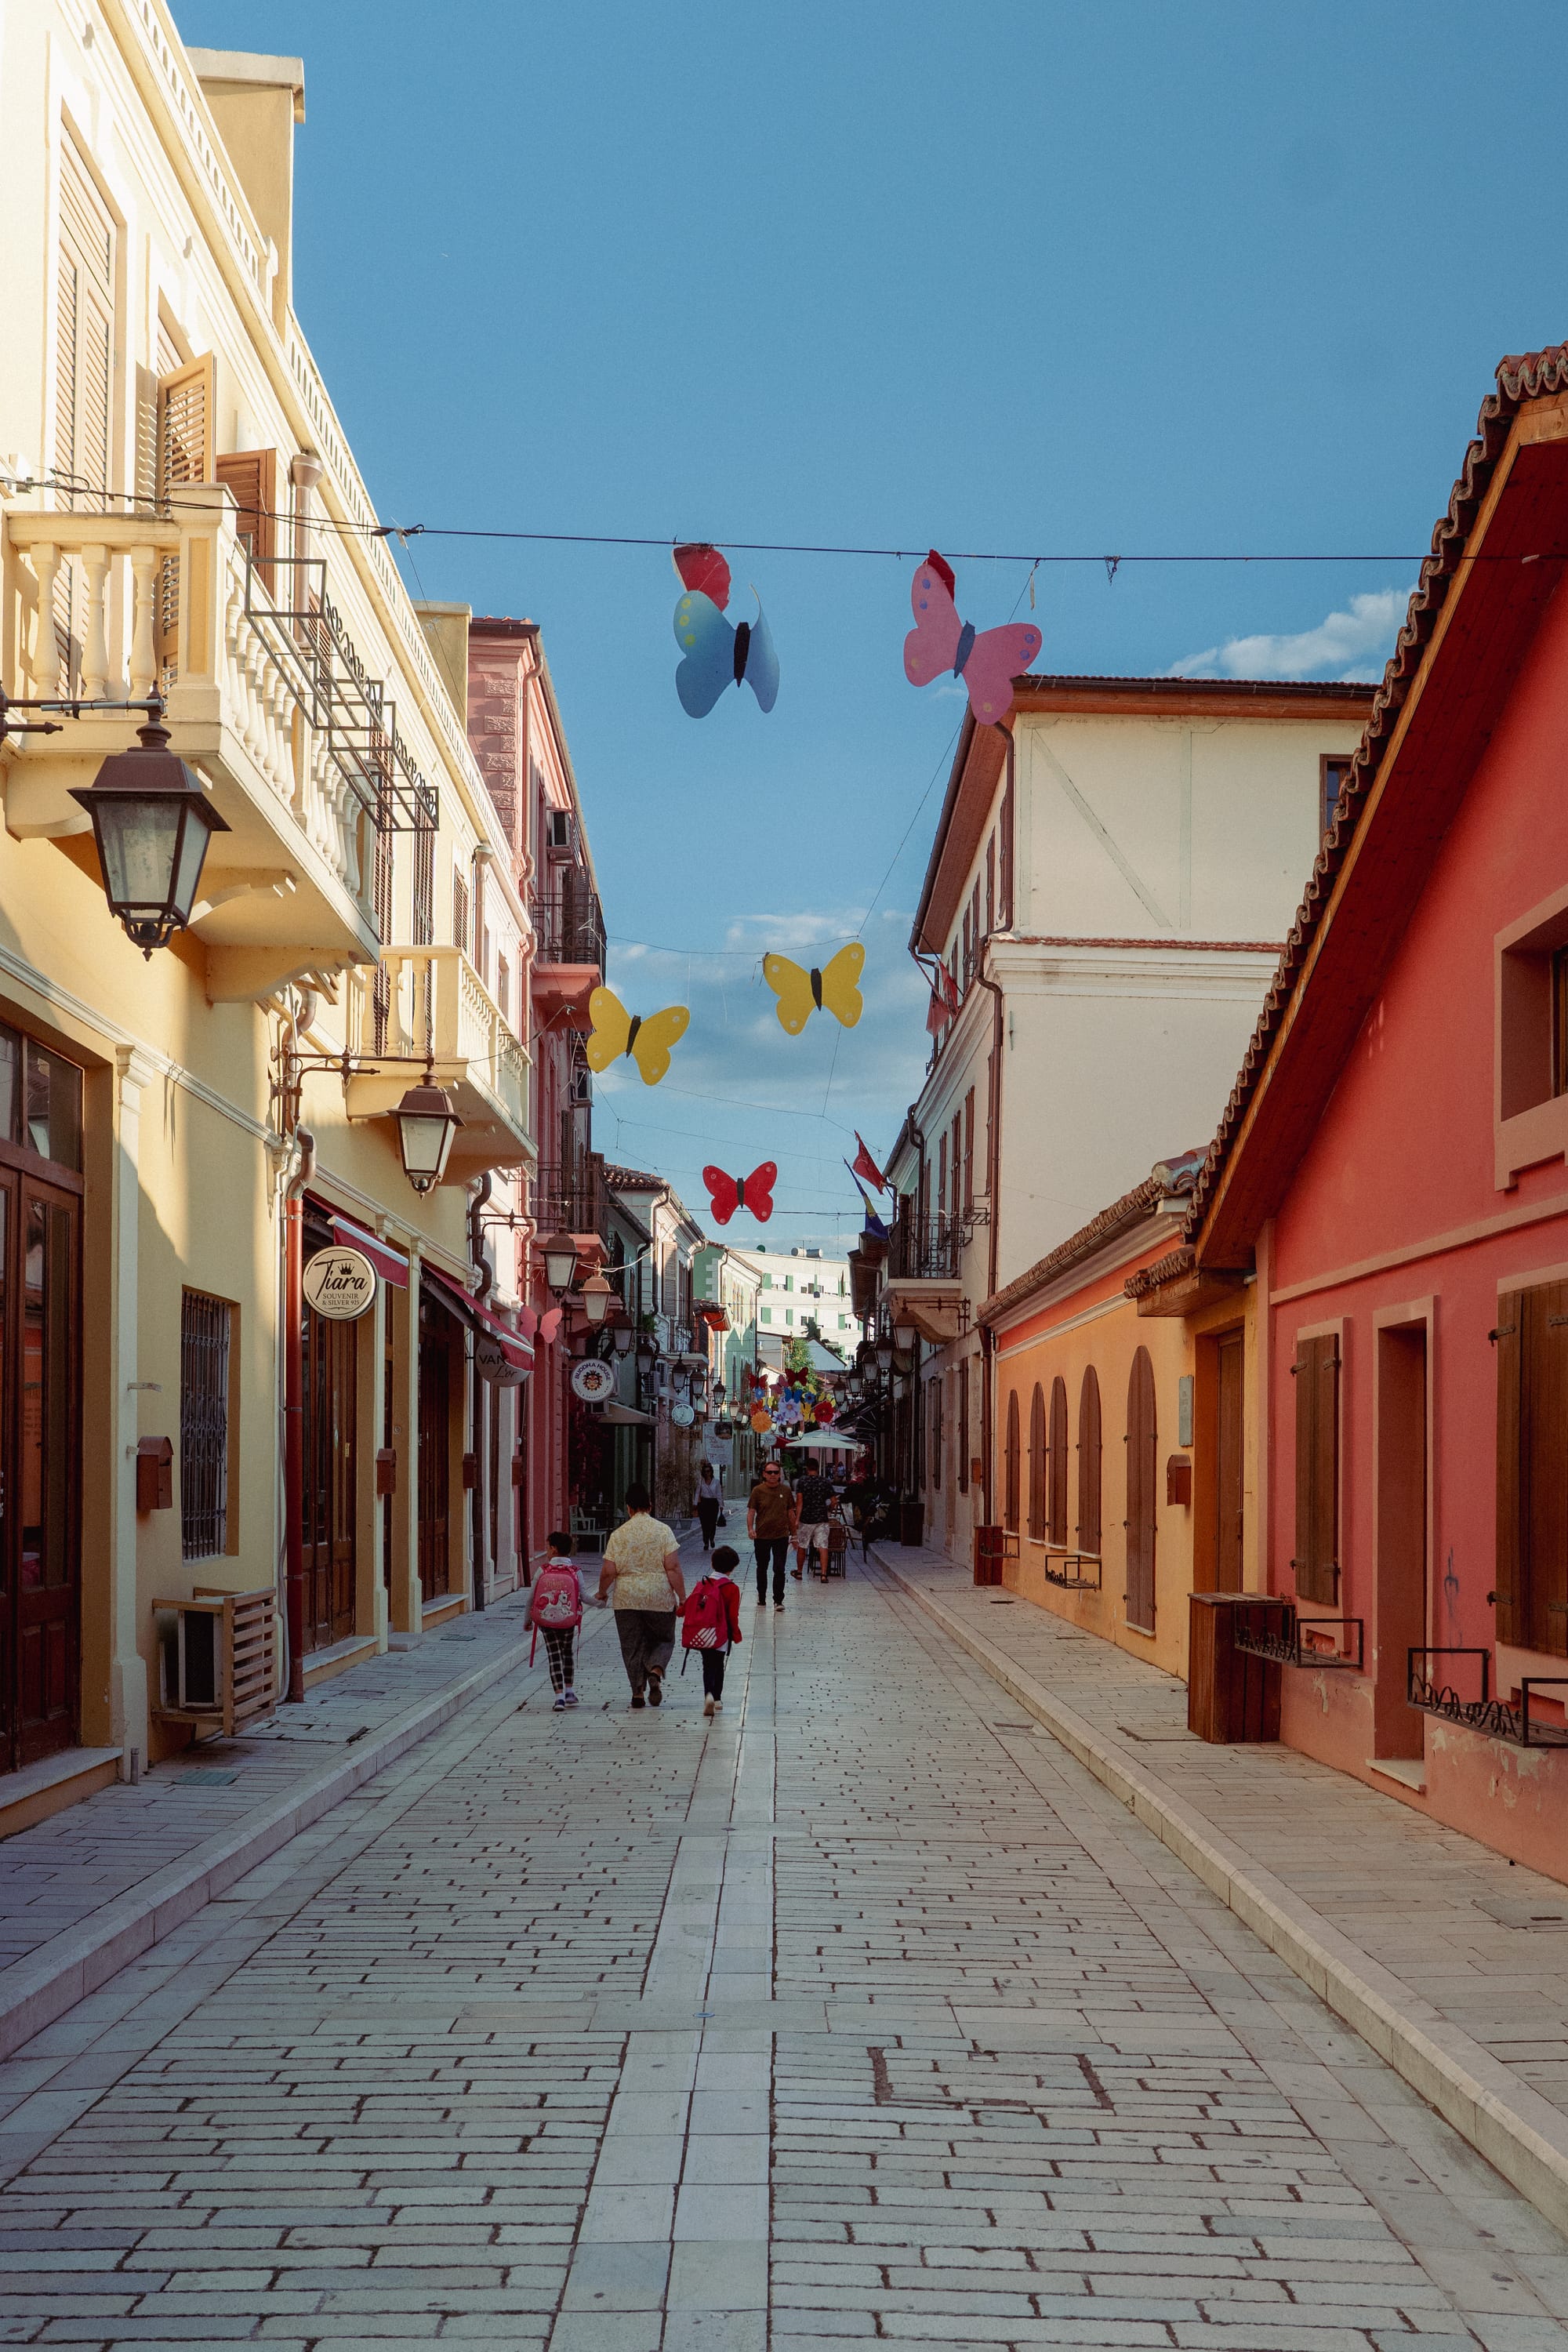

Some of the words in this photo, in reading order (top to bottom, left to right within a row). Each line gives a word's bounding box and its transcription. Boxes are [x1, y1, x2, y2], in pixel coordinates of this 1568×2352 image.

[314, 1258, 368, 1301] Tiara
[575, 1362, 596, 1380] BUDDHA
[597, 1363, 612, 1381] HOUSE
